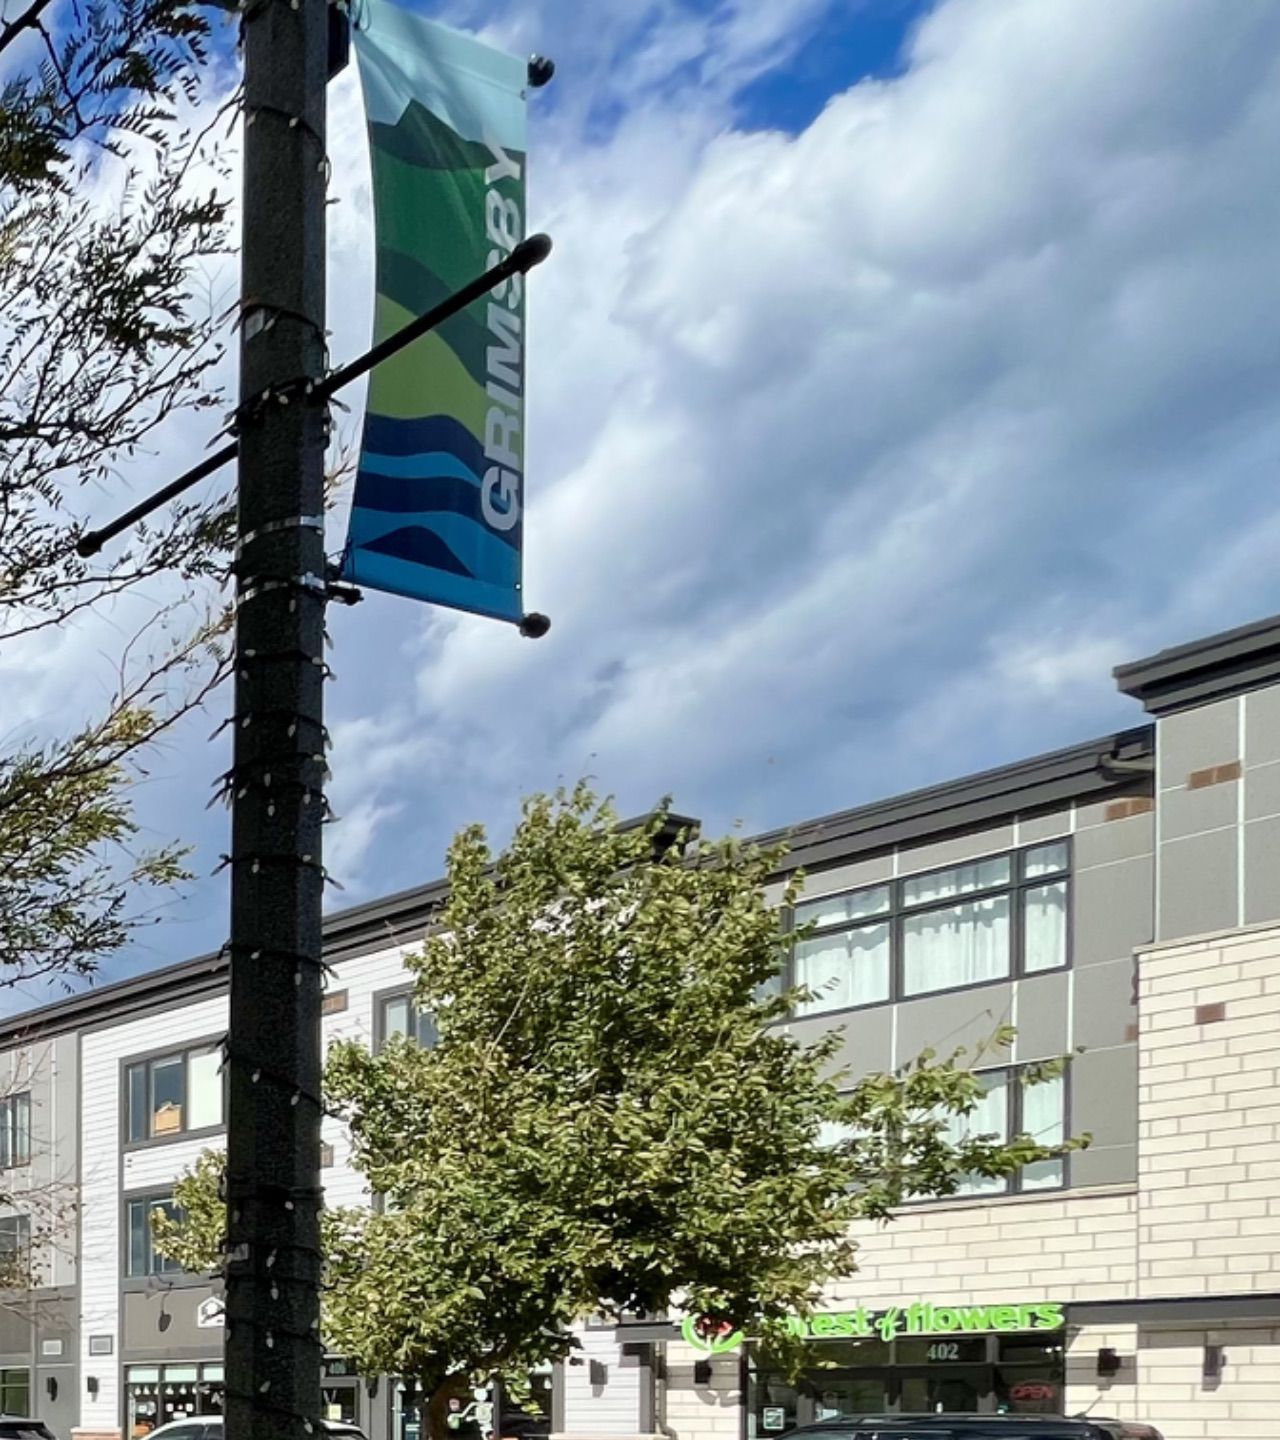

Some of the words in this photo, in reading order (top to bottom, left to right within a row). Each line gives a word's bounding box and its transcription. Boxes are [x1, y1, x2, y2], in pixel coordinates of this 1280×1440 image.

[481, 127, 521, 532] GRIMSBY
[905, 1302, 1065, 1333] flowers
[927, 1342, 959, 1360] 402
[1010, 1383, 1055, 1400] OPEN
